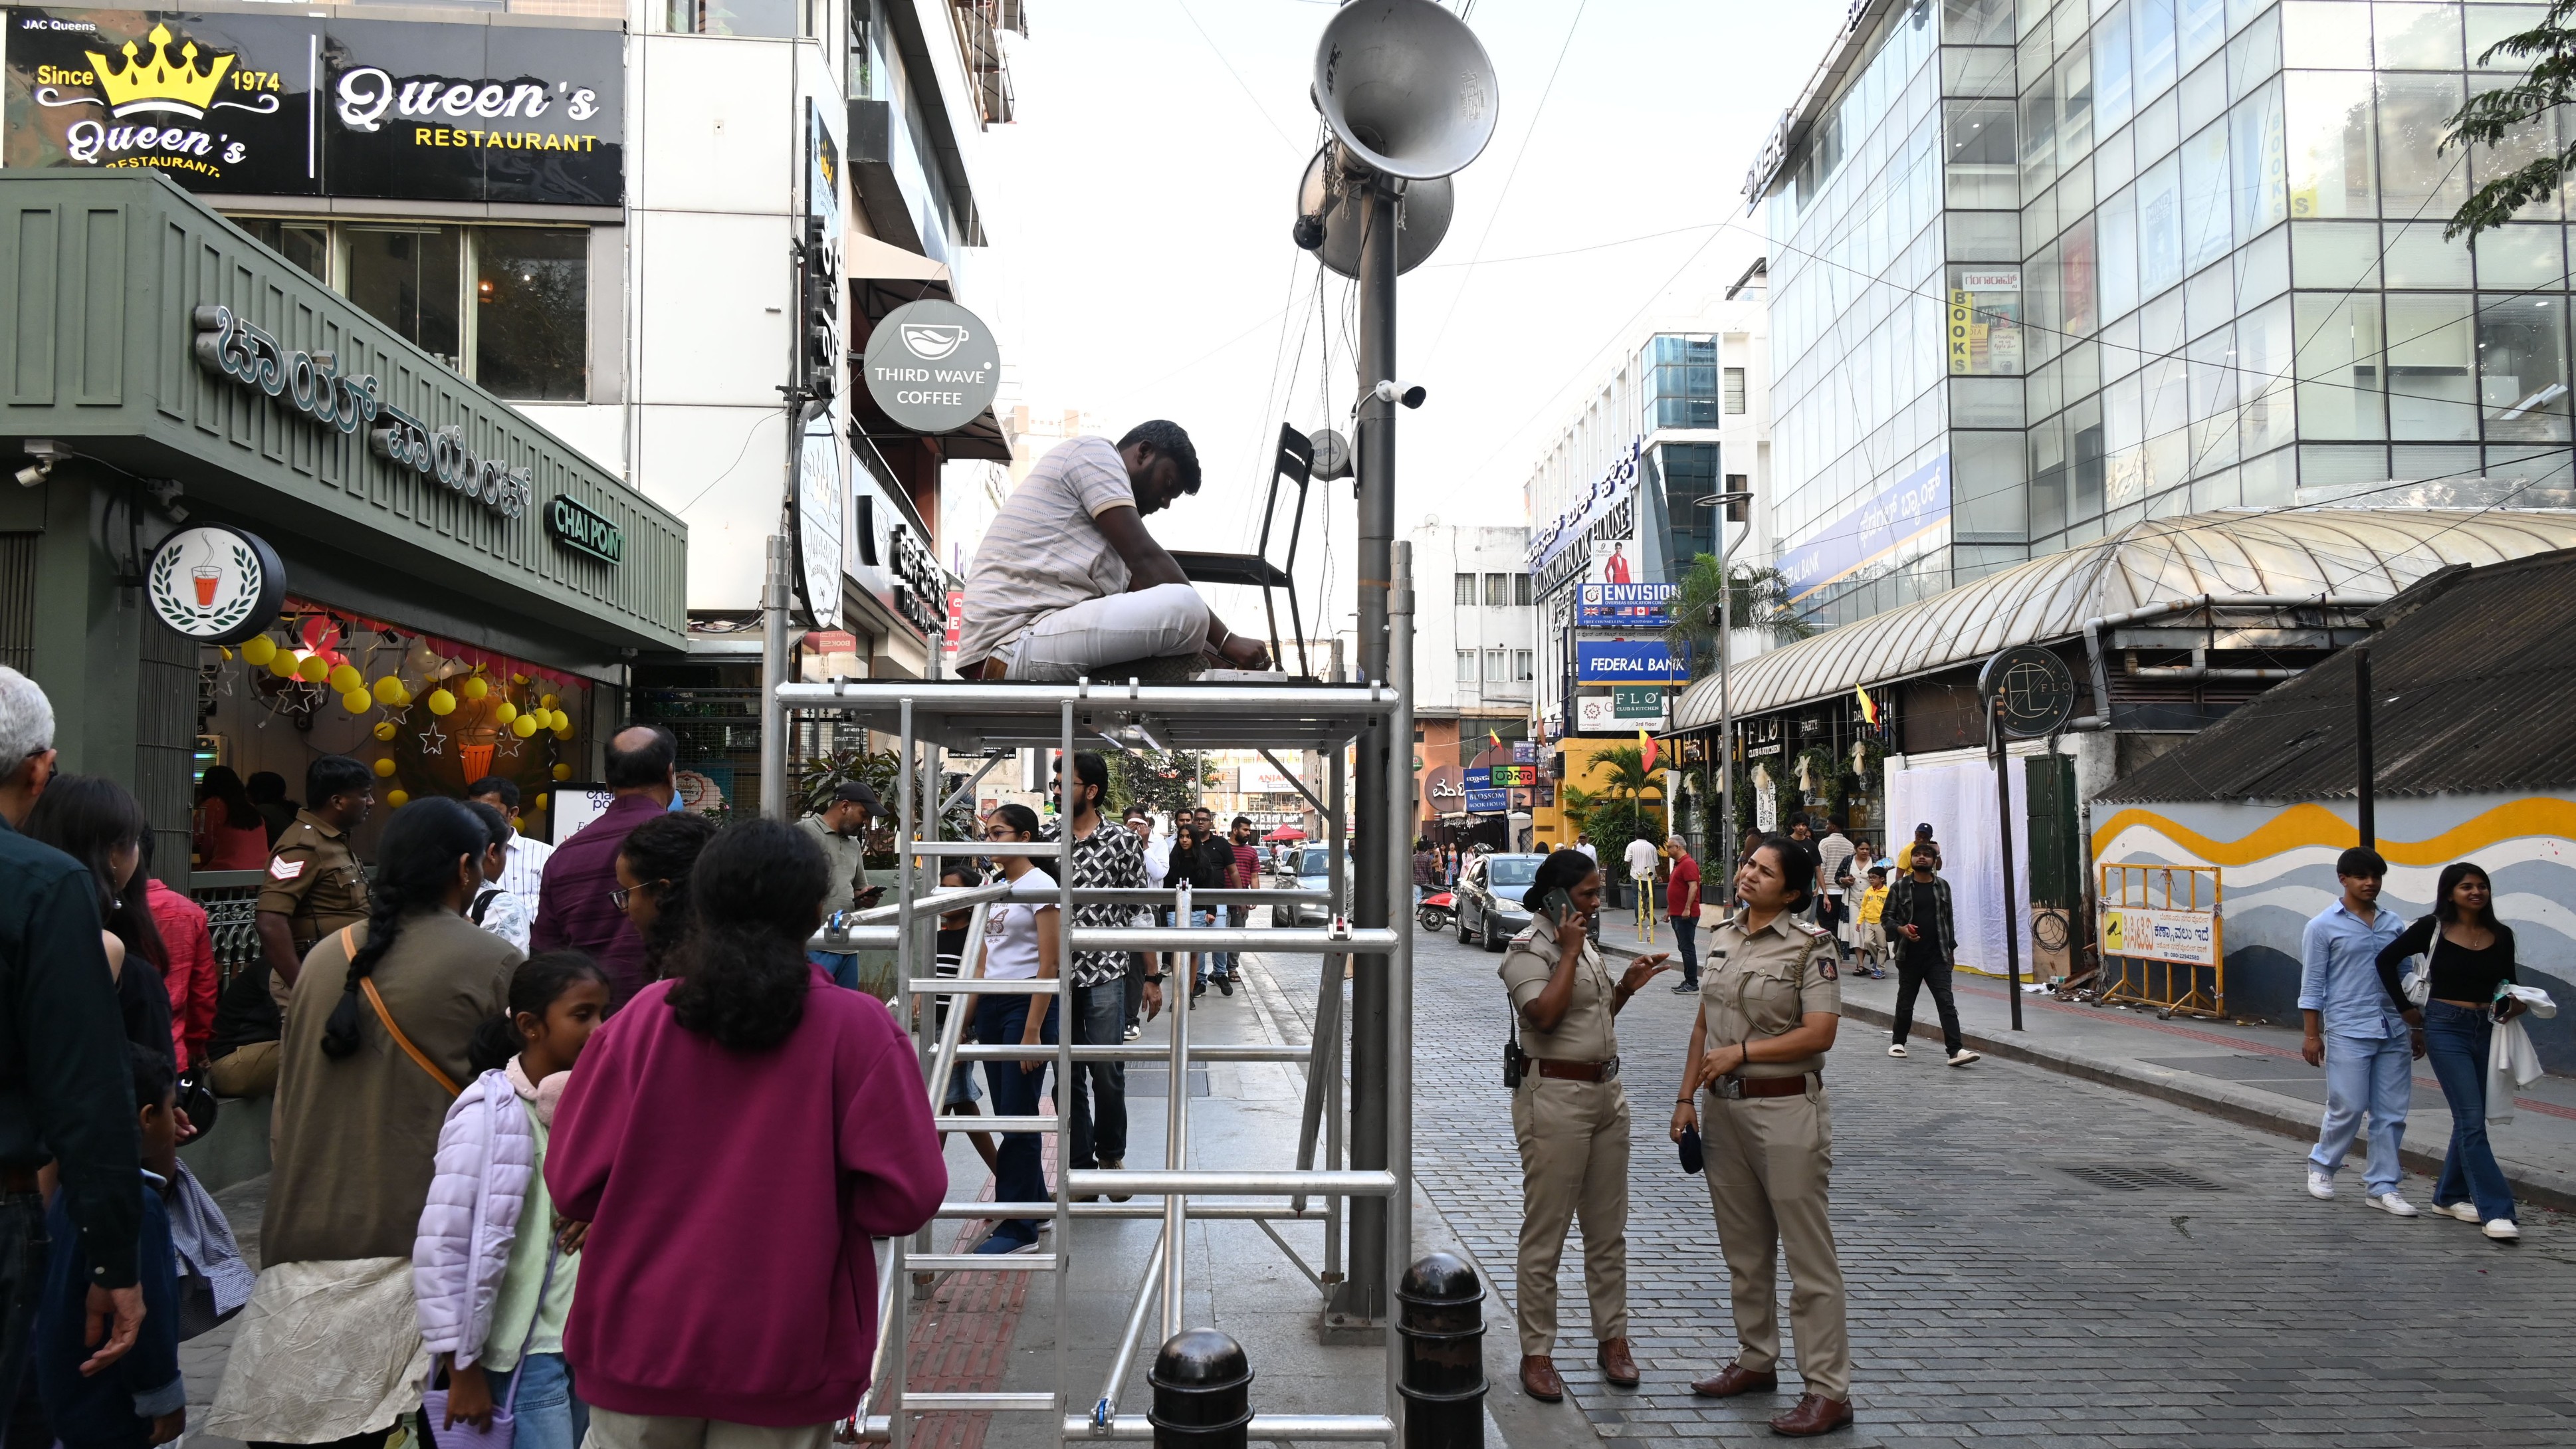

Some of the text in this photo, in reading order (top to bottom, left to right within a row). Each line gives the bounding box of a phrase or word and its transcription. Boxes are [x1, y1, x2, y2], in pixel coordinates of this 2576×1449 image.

[23, 19, 96, 32] JAC Queens
[38, 65, 94, 86] Since
[231, 71, 280, 92] 1974
[338, 67, 599, 132] Queen's
[67, 120, 247, 164] Queen's
[415, 128, 597, 153] RESTAURANT
[1953, 292, 1966, 372] BOOKS
[875, 368, 985, 384] THIRD WAVE
[897, 391, 962, 405] COFFEE
[1315, 446, 1337, 457] BPL
[554, 499, 626, 563] CHAI POINT
[1532, 500, 1629, 600] BLOSSOM BOOK HOUSE
[1802, 550, 1820, 580] BANK
[1591, 657, 1685, 671] FEDERAL BANK
[2041, 682, 2070, 693] FLO
[1801, 719, 1819, 732] PARTY
[1748, 748, 1759, 758] CLUB
[1762, 744, 1780, 756] KITCHEN
[2195, 927, 2208, 941] ಇದೆ
